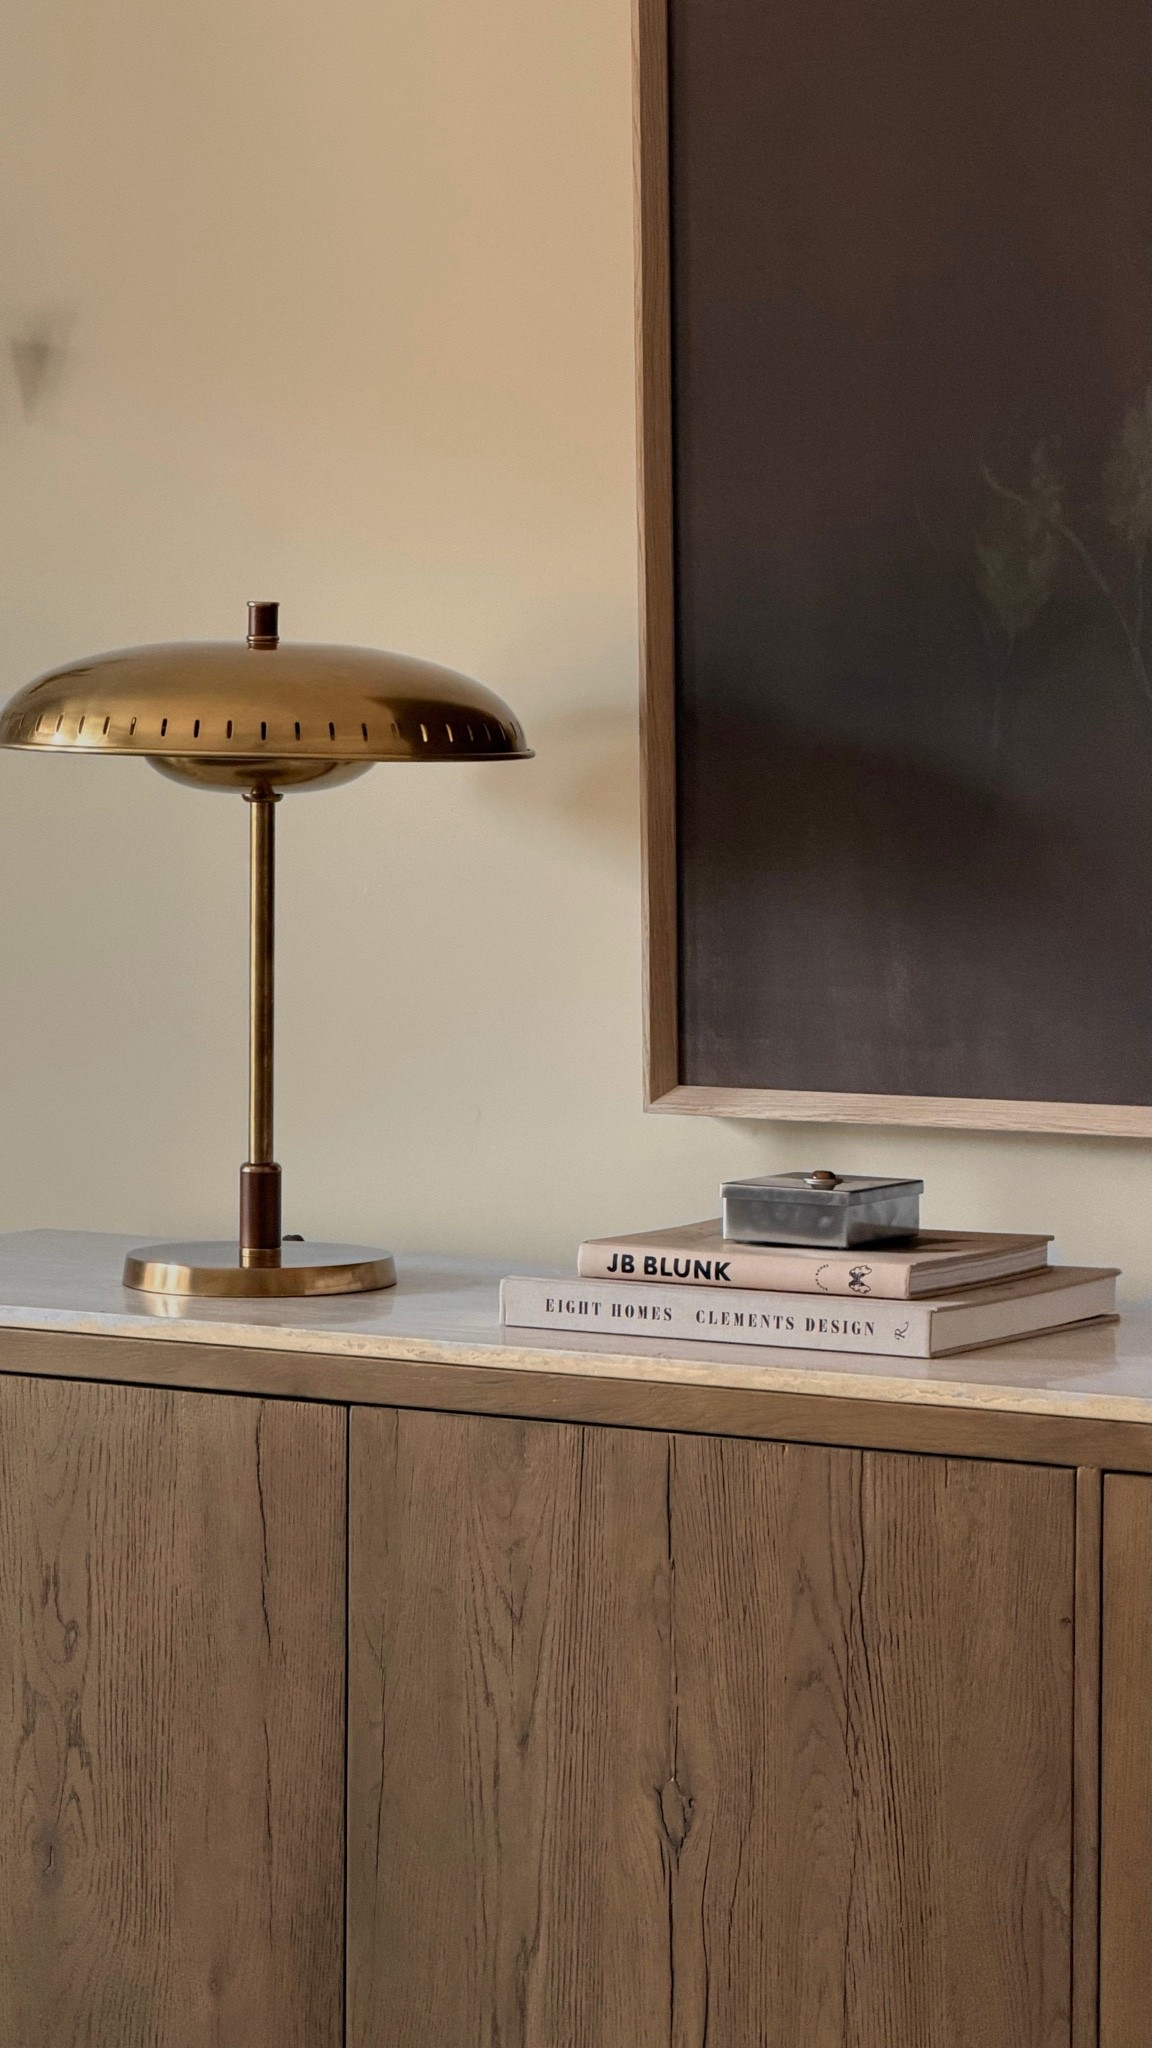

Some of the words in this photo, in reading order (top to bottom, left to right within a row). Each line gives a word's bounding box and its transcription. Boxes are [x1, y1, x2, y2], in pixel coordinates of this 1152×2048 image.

[606, 1253, 635, 1274] JB
[643, 1255, 731, 1282] BLUNK
[545, 1298, 602, 1316] EIGHT
[611, 1303, 673, 1322] HOMES
[695, 1309, 795, 1331] CLEMENTS
[804, 1317, 875, 1337] DESIGN
